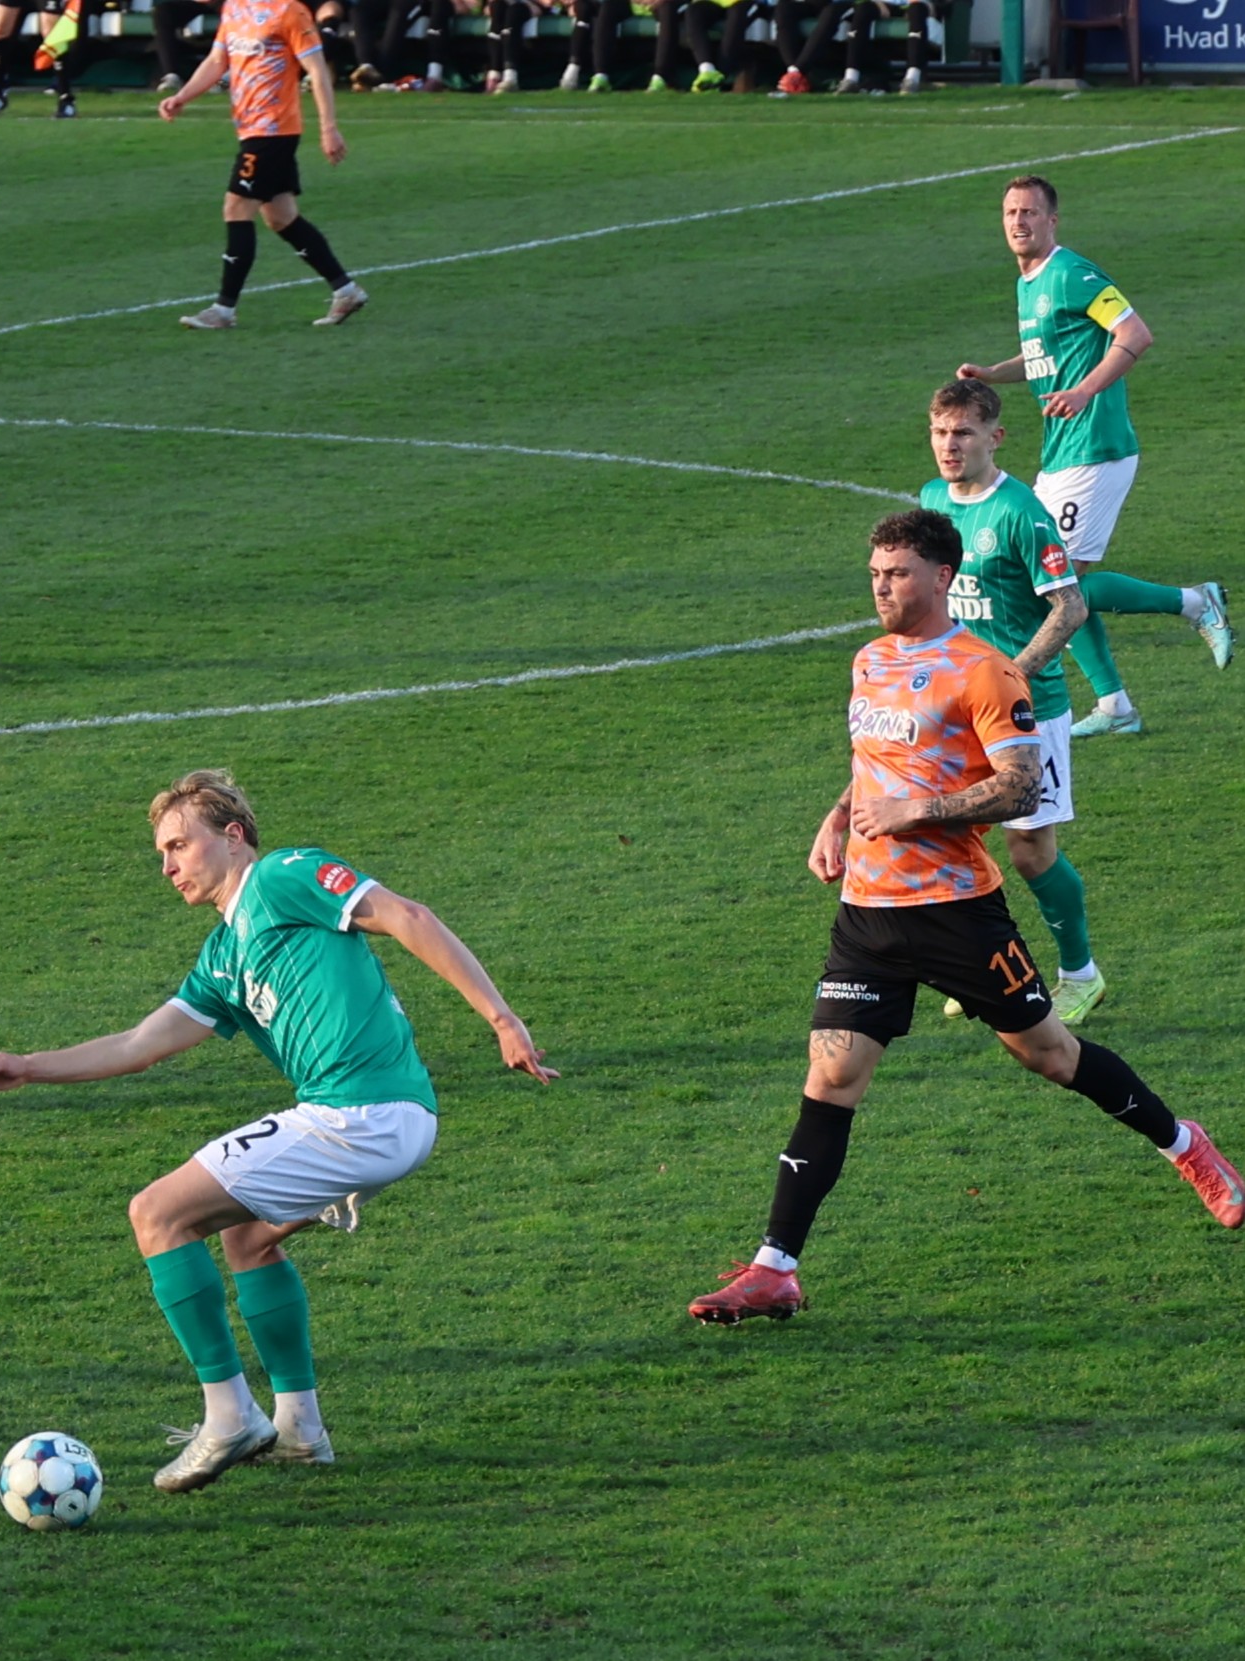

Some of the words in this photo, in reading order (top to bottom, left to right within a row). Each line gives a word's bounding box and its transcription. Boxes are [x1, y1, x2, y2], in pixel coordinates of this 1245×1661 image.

[1164, 23, 1229, 49] Hvad
[239, 153, 256, 179] 3
[1059, 501, 1079, 532] 8
[1039, 754, 1061, 795] 1
[988, 939, 1037, 996] 11
[235, 1119, 279, 1151] 2
